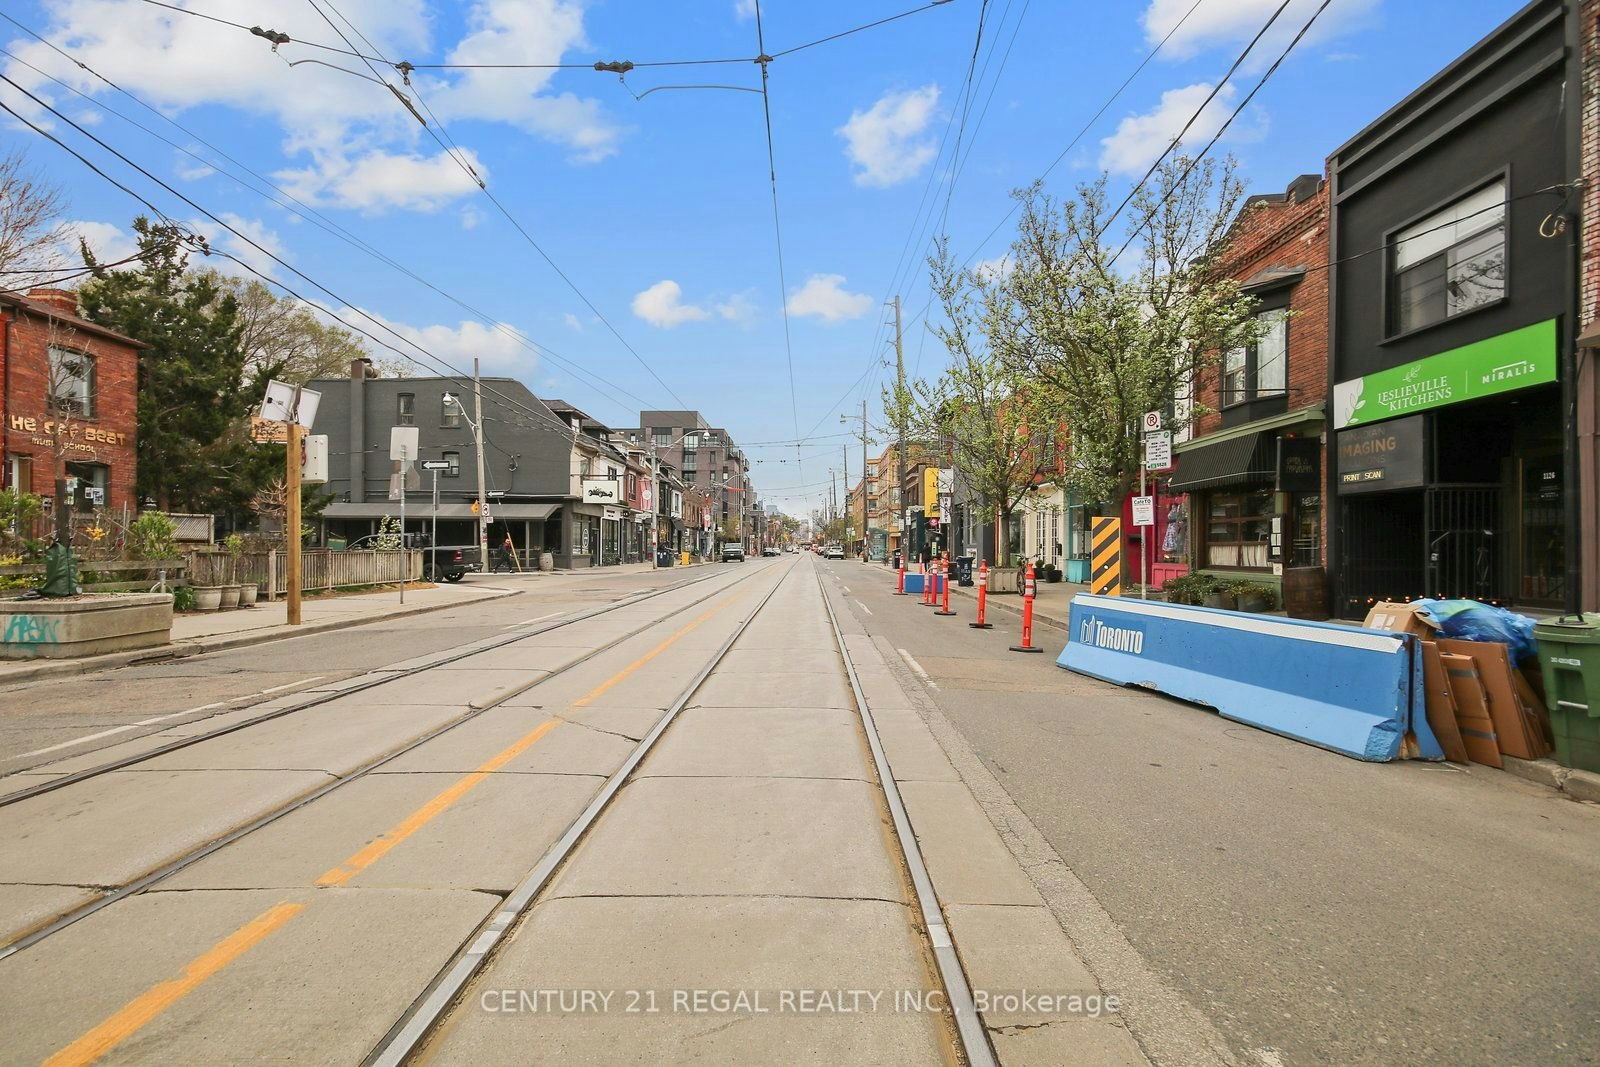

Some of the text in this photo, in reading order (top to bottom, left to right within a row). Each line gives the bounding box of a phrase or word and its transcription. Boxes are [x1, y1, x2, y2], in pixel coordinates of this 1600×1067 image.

[1378, 375, 1448, 406] LESLIEVILLE
[1389, 386, 1451, 412] KITCHENS
[63, 441, 96, 453] SCHOOL
[1343, 470, 1382, 482] PRINT SCAN
[1095, 620, 1144, 654] TORONTO
